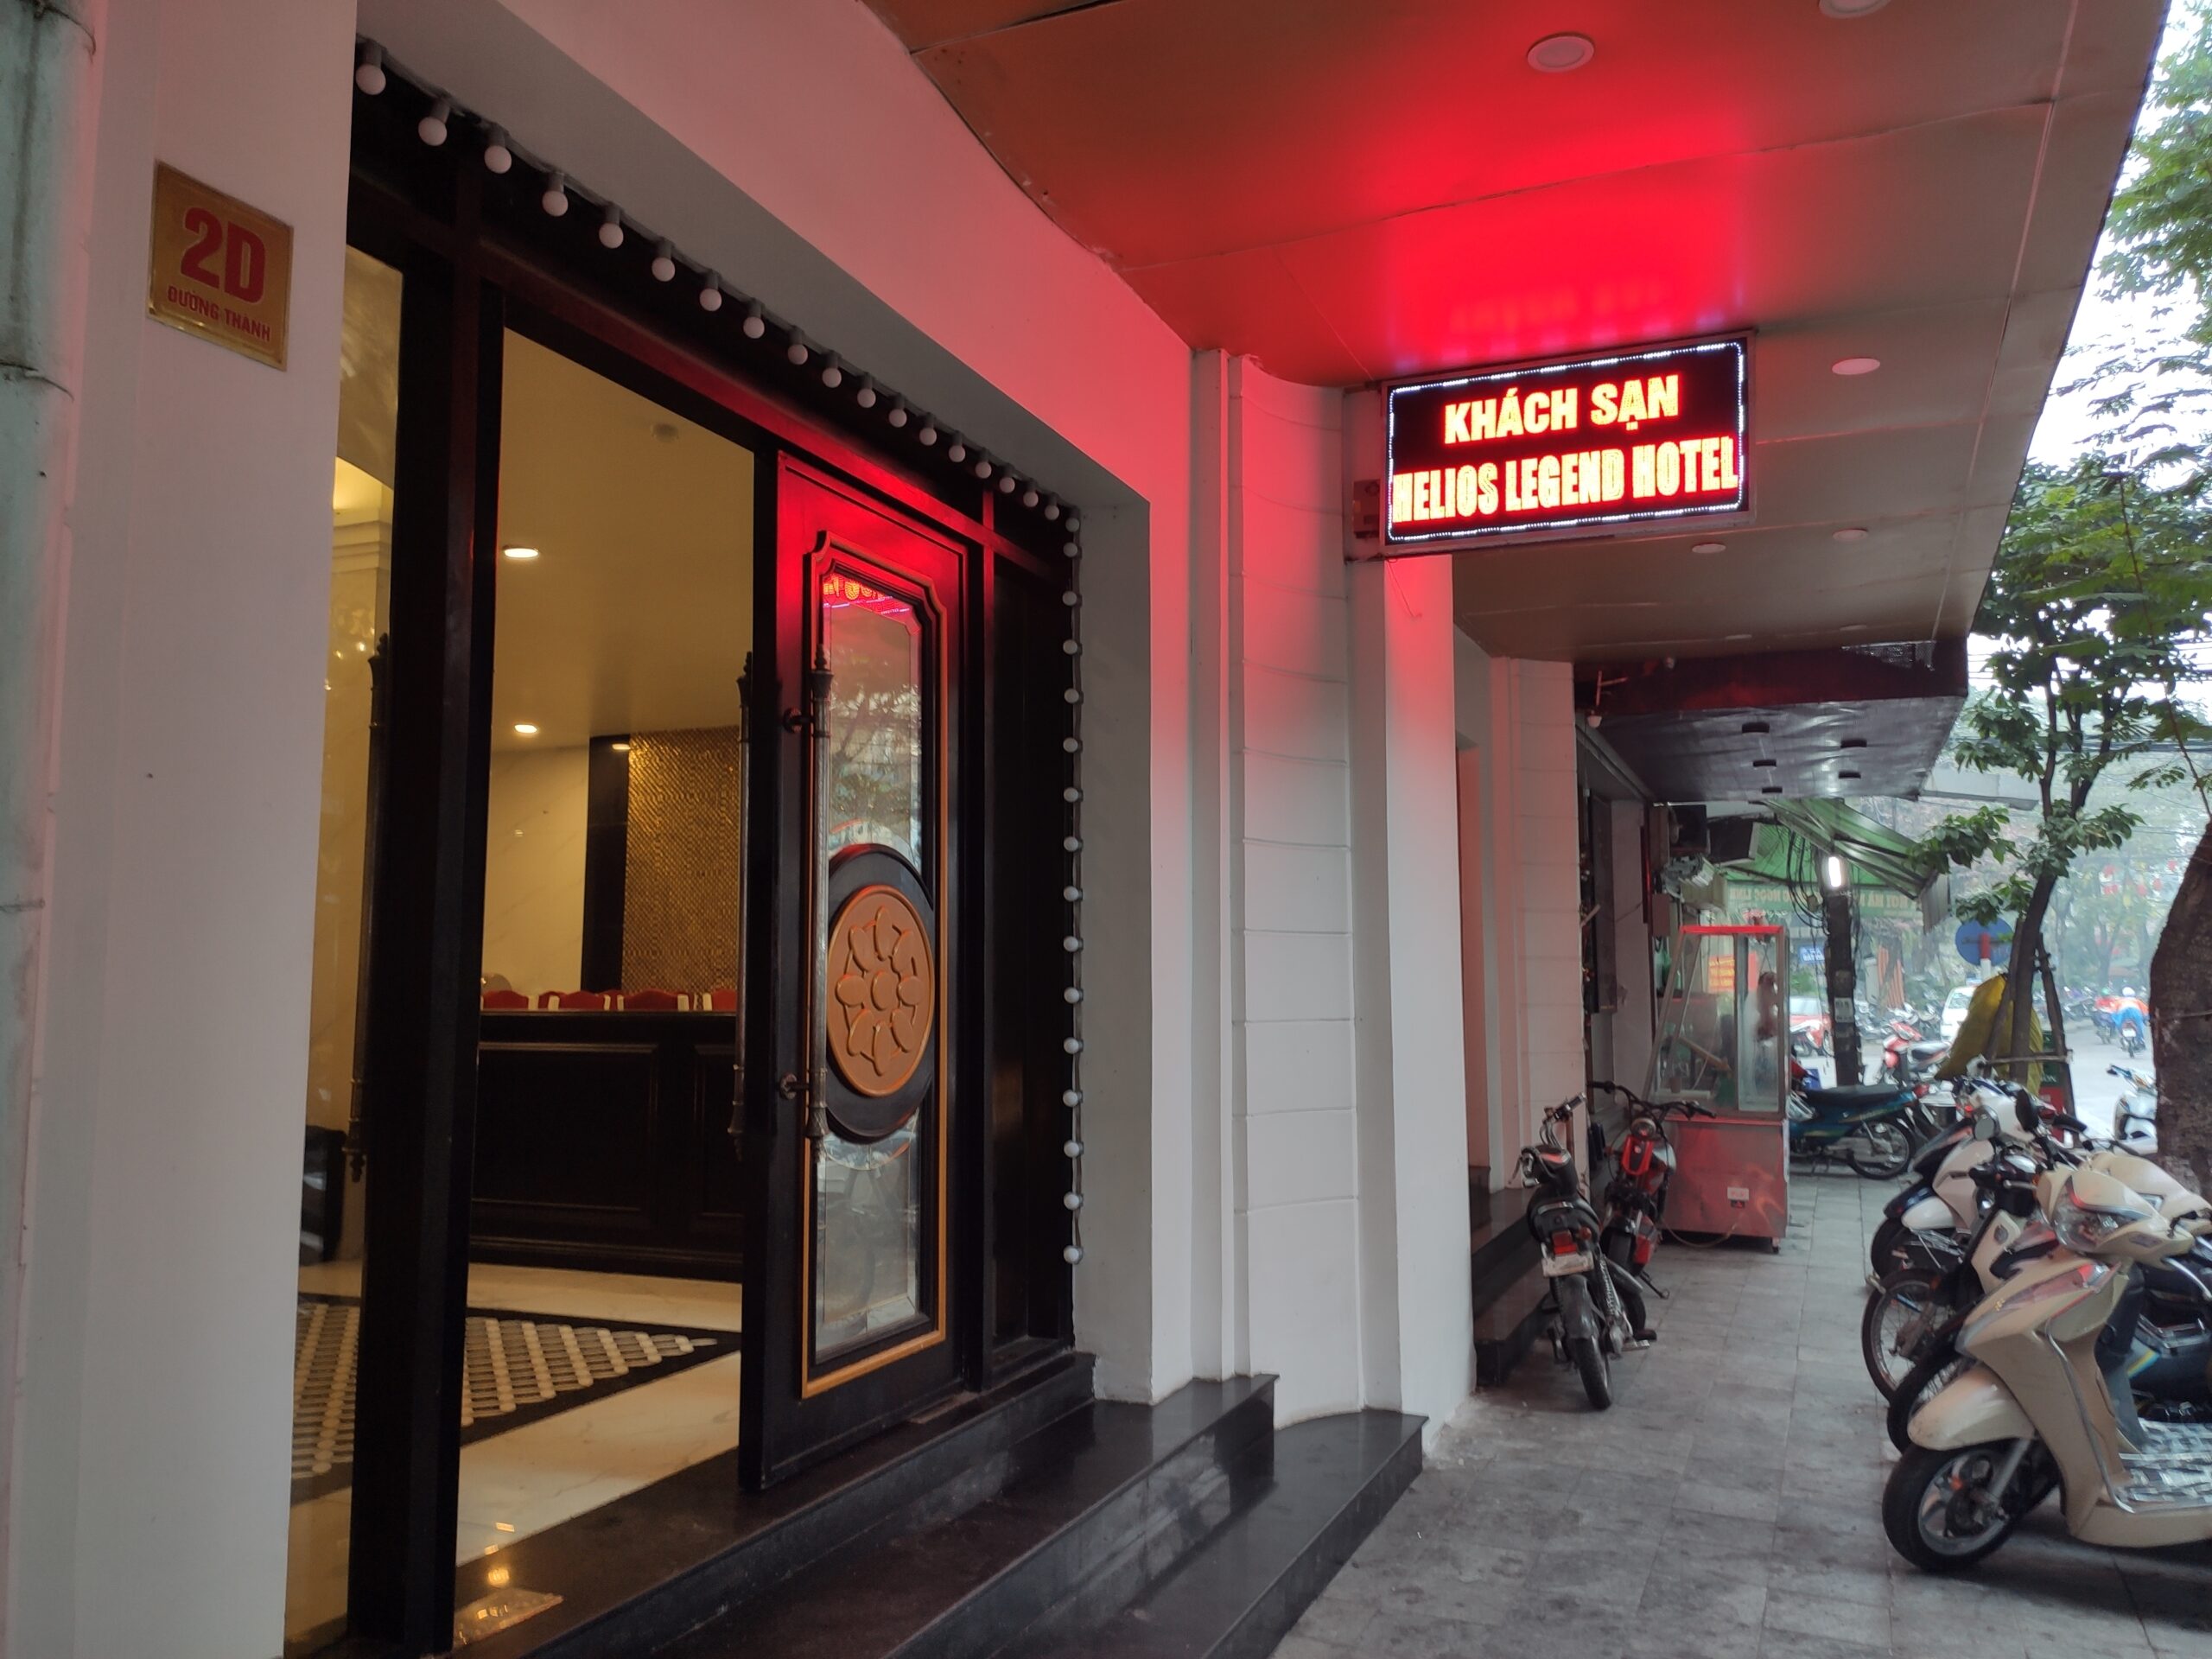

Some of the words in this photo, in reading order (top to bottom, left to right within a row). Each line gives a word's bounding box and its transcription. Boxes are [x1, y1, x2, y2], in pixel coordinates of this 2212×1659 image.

[181, 207, 266, 303] 2D
[224, 307, 270, 342] THÀNH
[1444, 387, 1579, 445] KHÁCH
[1591, 374, 1680, 431] SẠN
[1392, 461, 1499, 524] HELIOS
[1505, 448, 1625, 512] LEGEND
[1631, 435, 1739, 499] HOTEL
